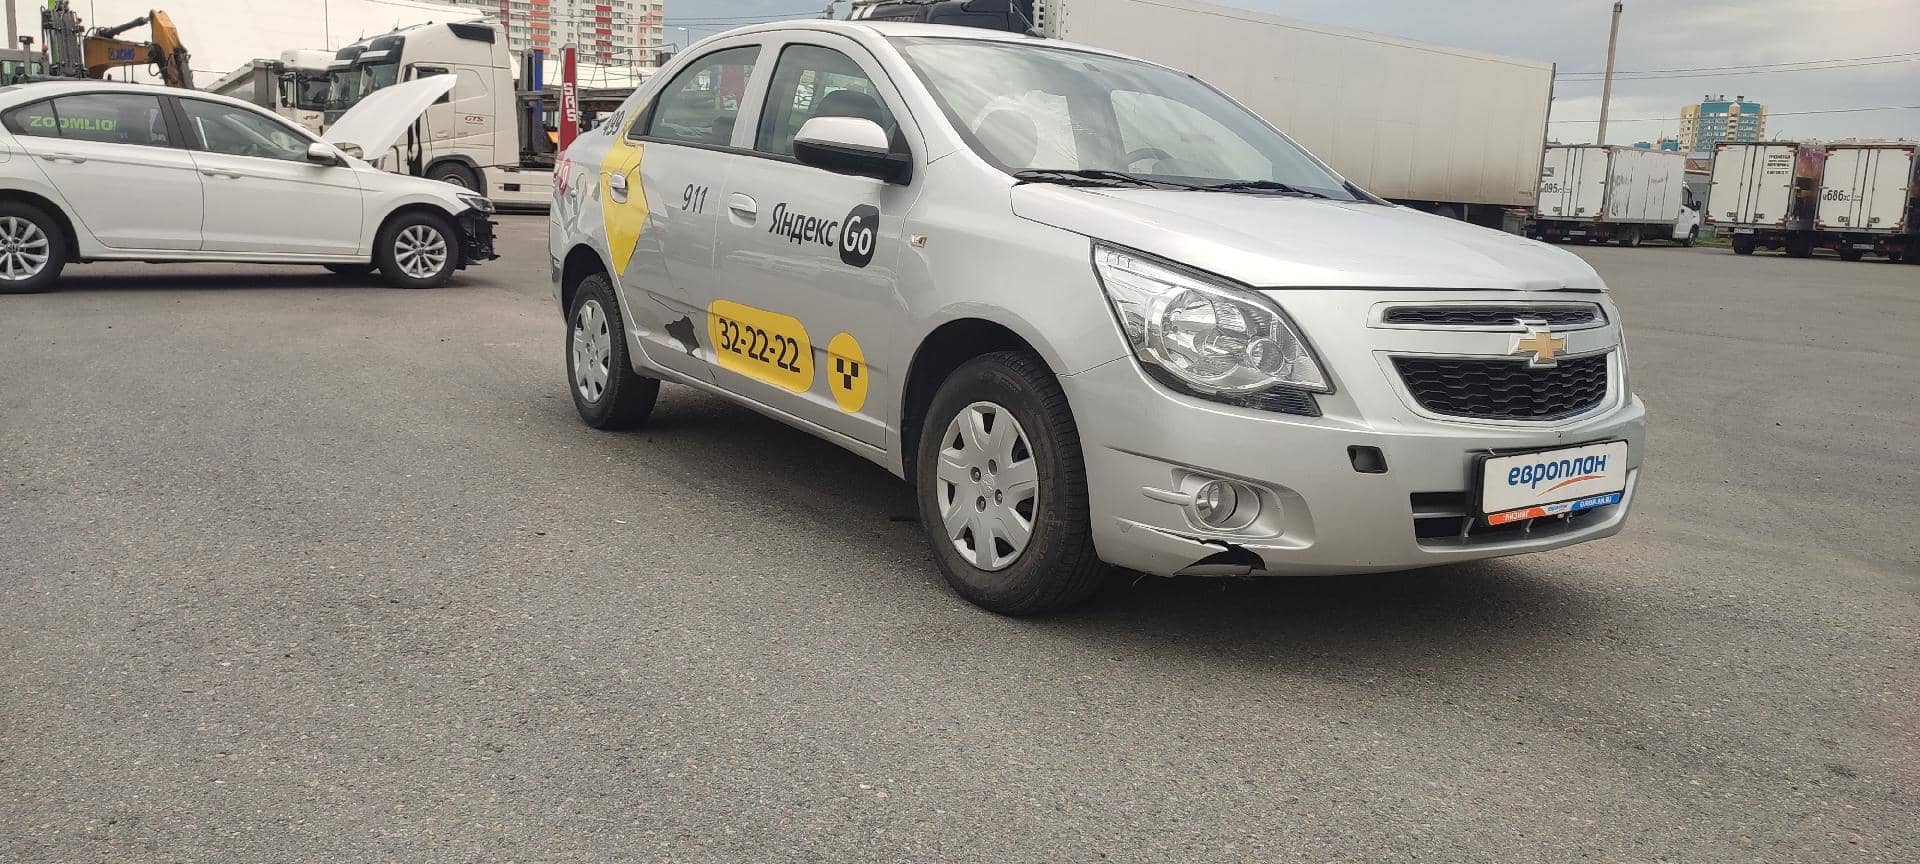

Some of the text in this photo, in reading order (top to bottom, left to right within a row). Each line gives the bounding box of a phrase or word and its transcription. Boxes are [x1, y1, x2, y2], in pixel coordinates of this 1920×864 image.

[681, 183, 708, 214] 911
[768, 203, 873, 256] Яндекс Go
[719, 317, 801, 374] 32-22-22
[1508, 454, 1608, 490] европлан
